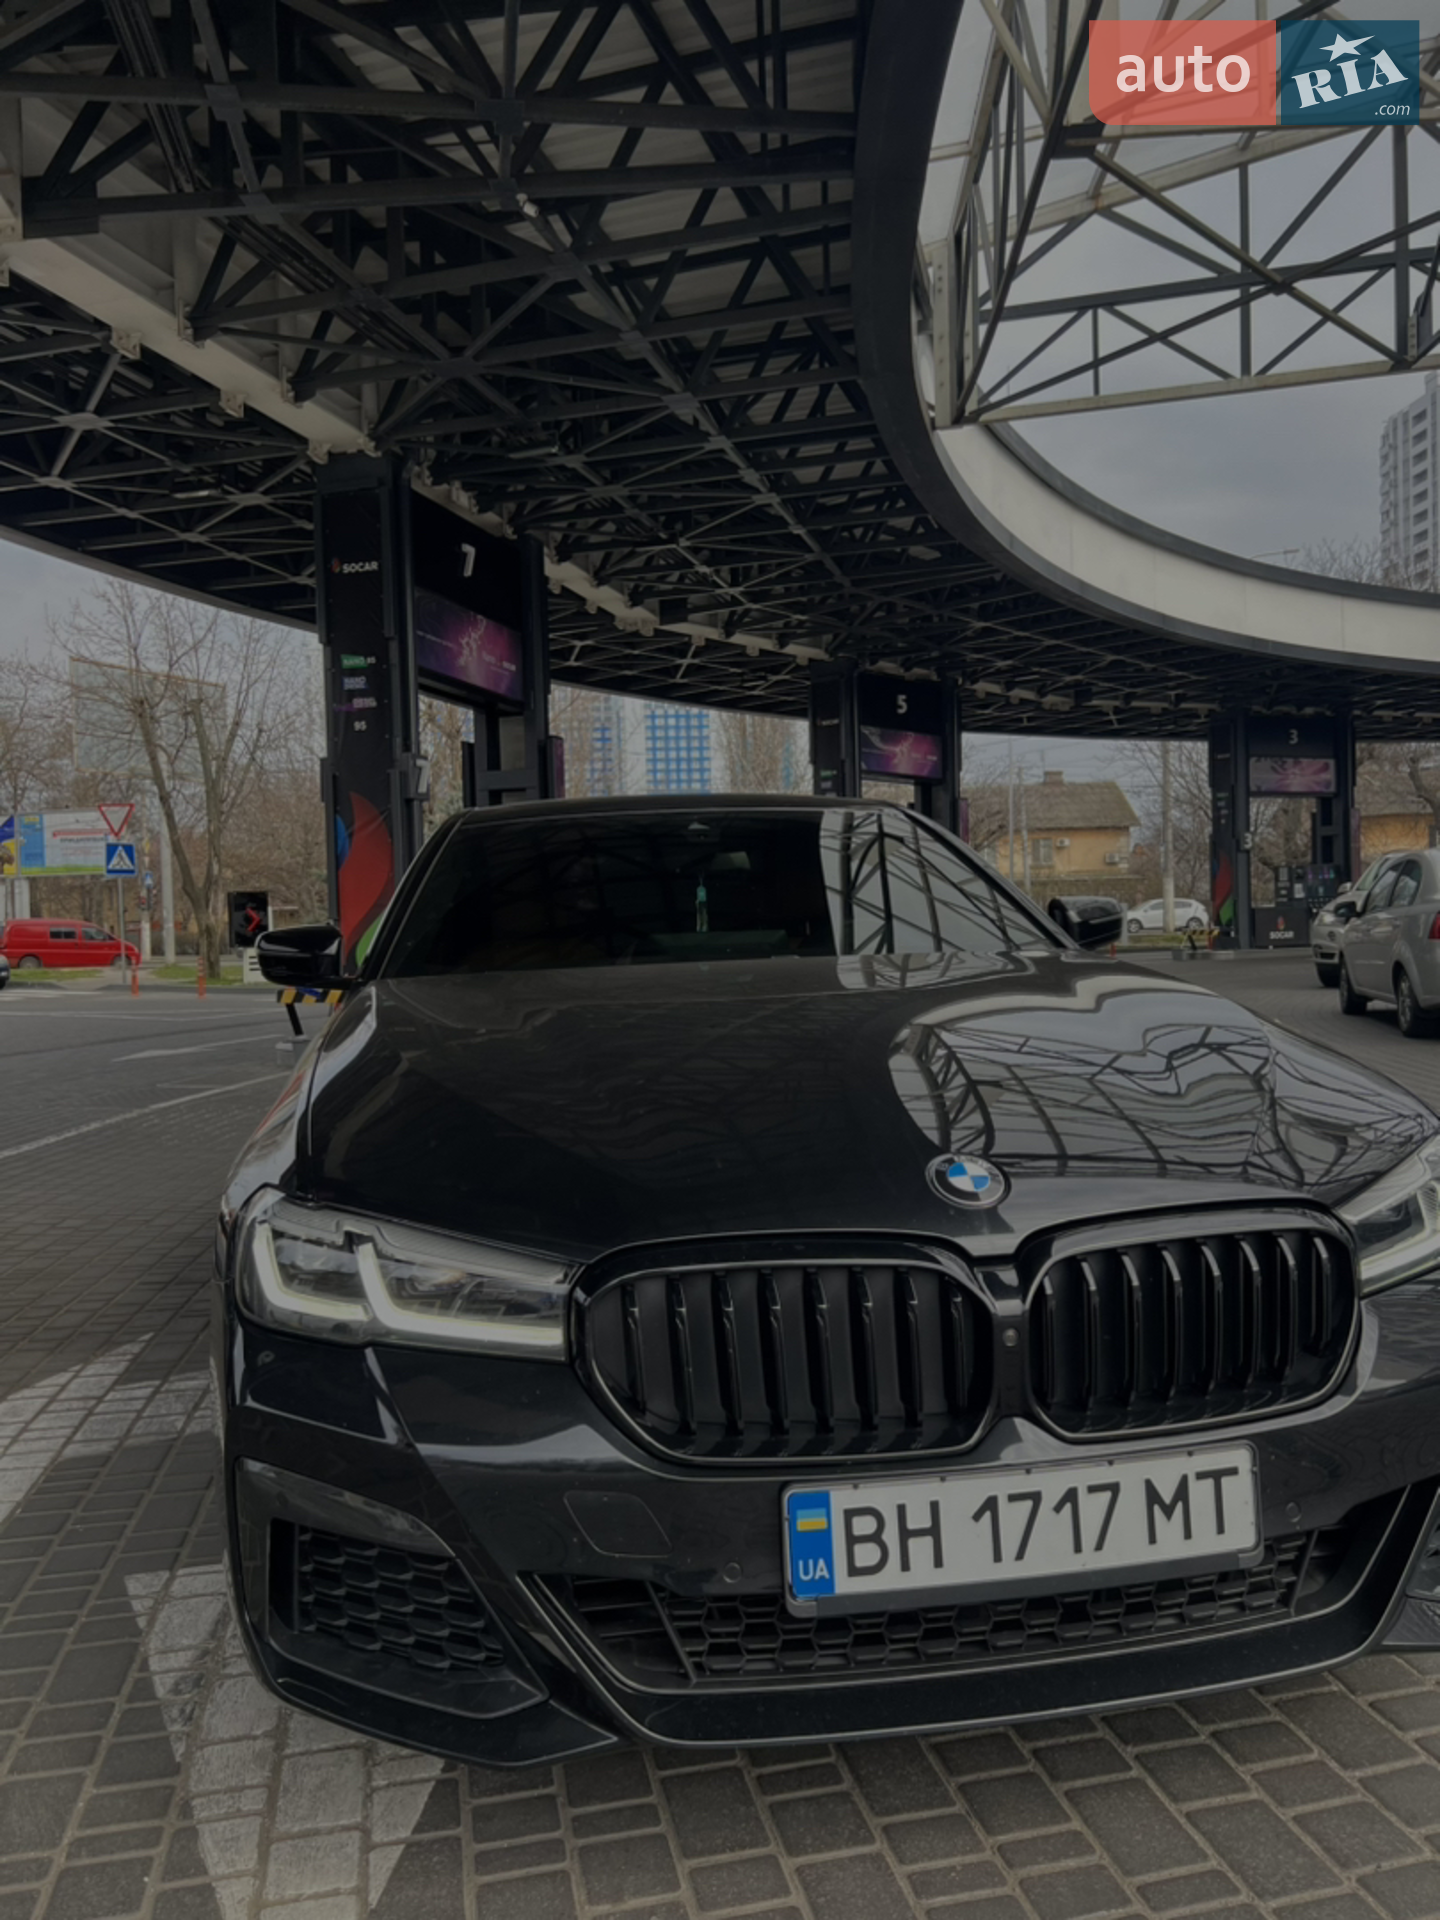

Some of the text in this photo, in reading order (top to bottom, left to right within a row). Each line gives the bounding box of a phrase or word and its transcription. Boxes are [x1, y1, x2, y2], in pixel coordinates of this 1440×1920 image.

[342, 560, 380, 574] SOCAR
[461, 543, 476, 577] 7
[896, 694, 908, 714] 5
[1289, 729, 1299, 745] 3
[415, 759, 430, 794] 7
[1244, 833, 1253, 849] 3
[843, 1466, 1240, 1578] BH 1717 MT
[798, 1558, 830, 1582] UA
